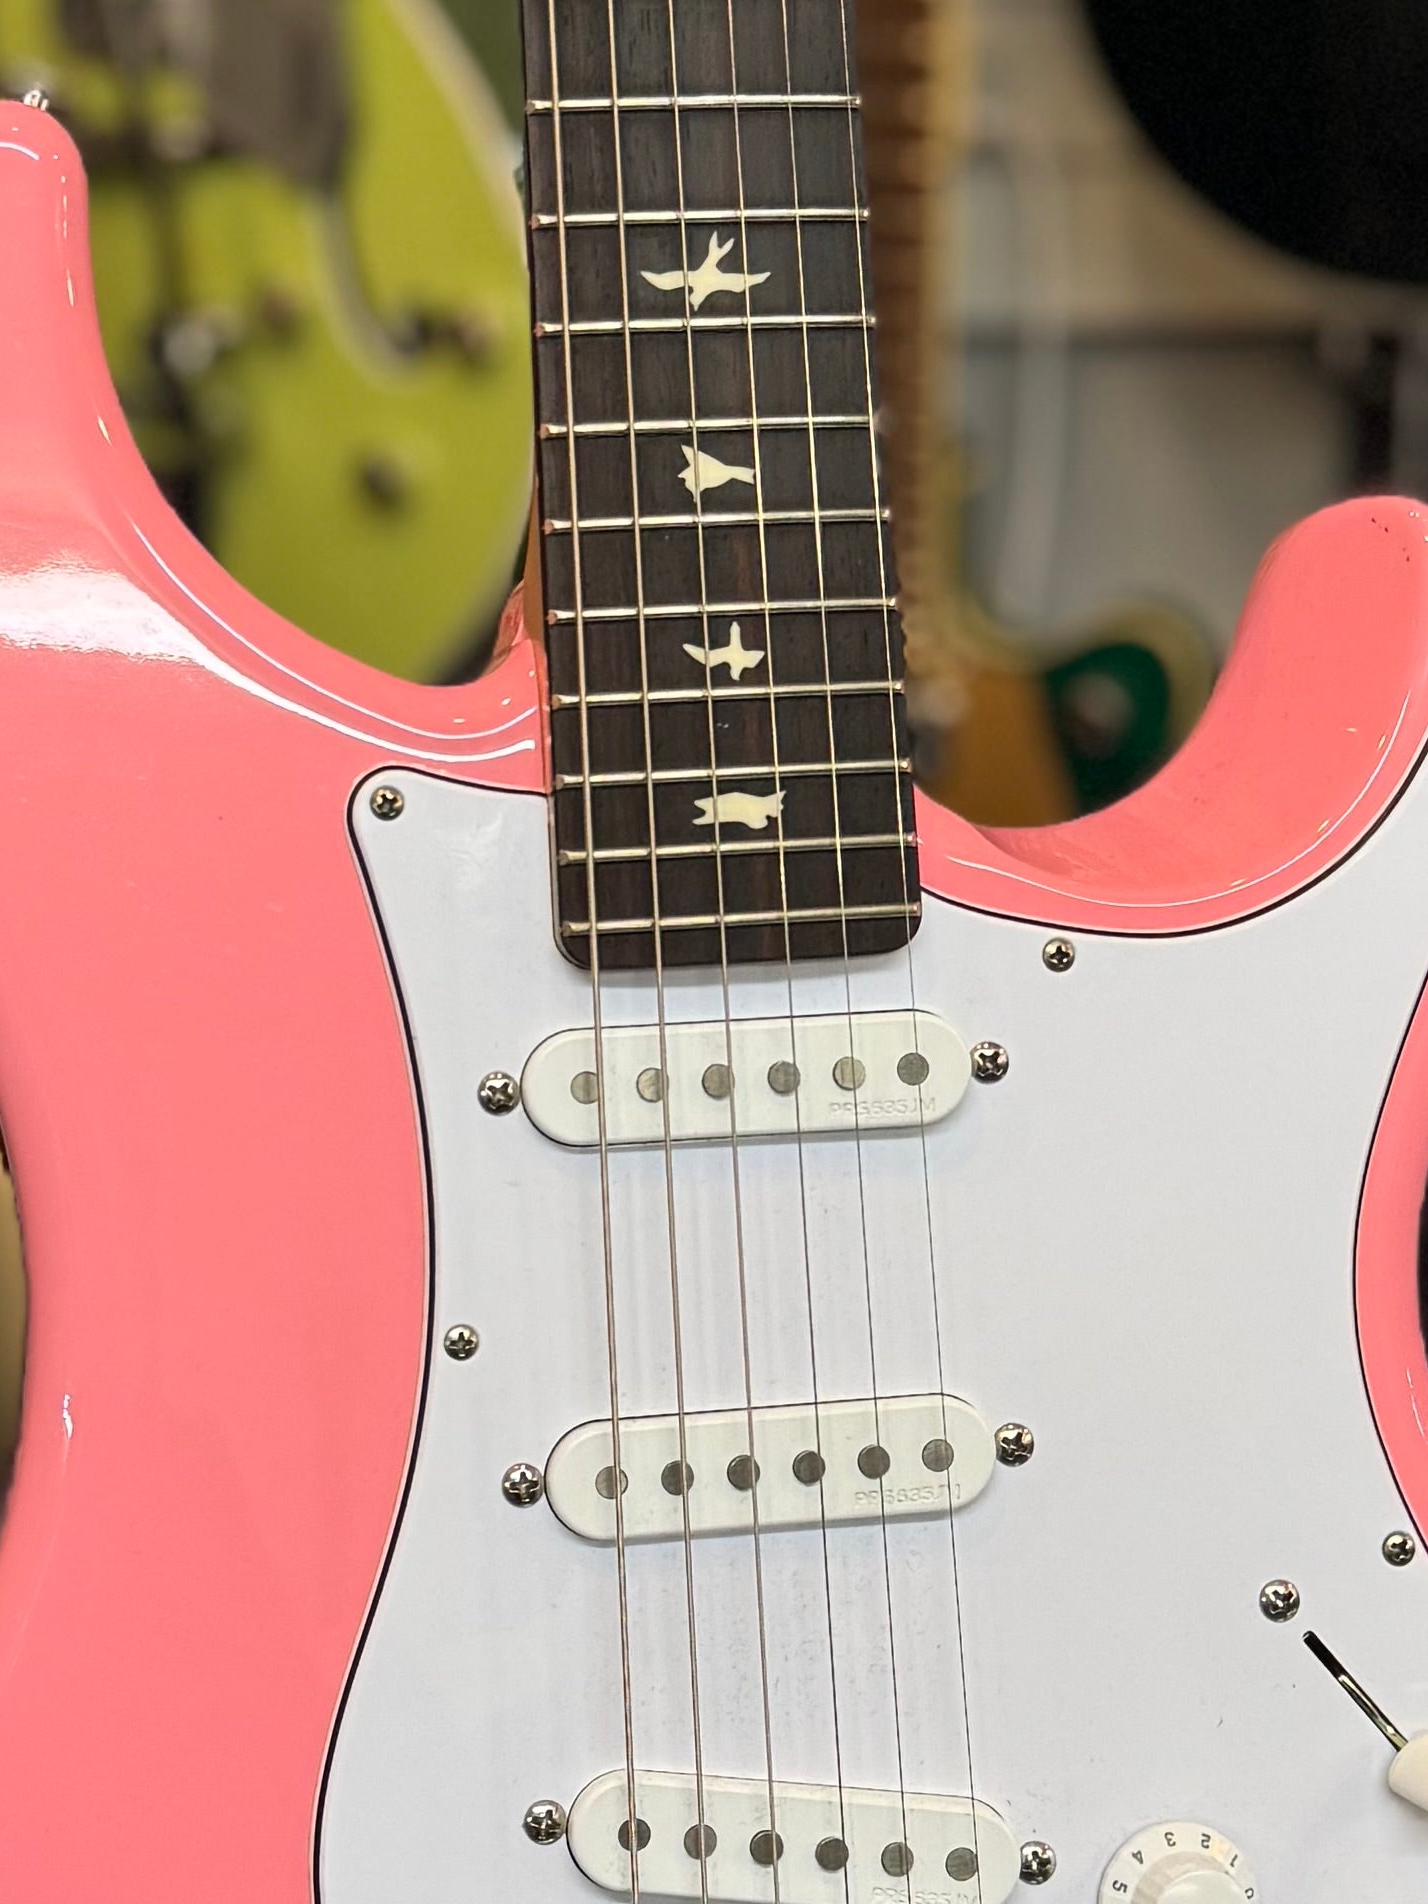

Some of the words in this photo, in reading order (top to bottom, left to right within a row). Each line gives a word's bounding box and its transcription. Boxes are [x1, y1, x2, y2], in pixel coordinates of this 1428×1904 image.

[1164, 1832, 1176, 1847] 3
[1201, 1833, 1211, 1849] 2
[1132, 1850, 1144, 1865] 4
[1229, 1854, 1238, 1867] 1
[1112, 1880, 1127, 1893] 5
